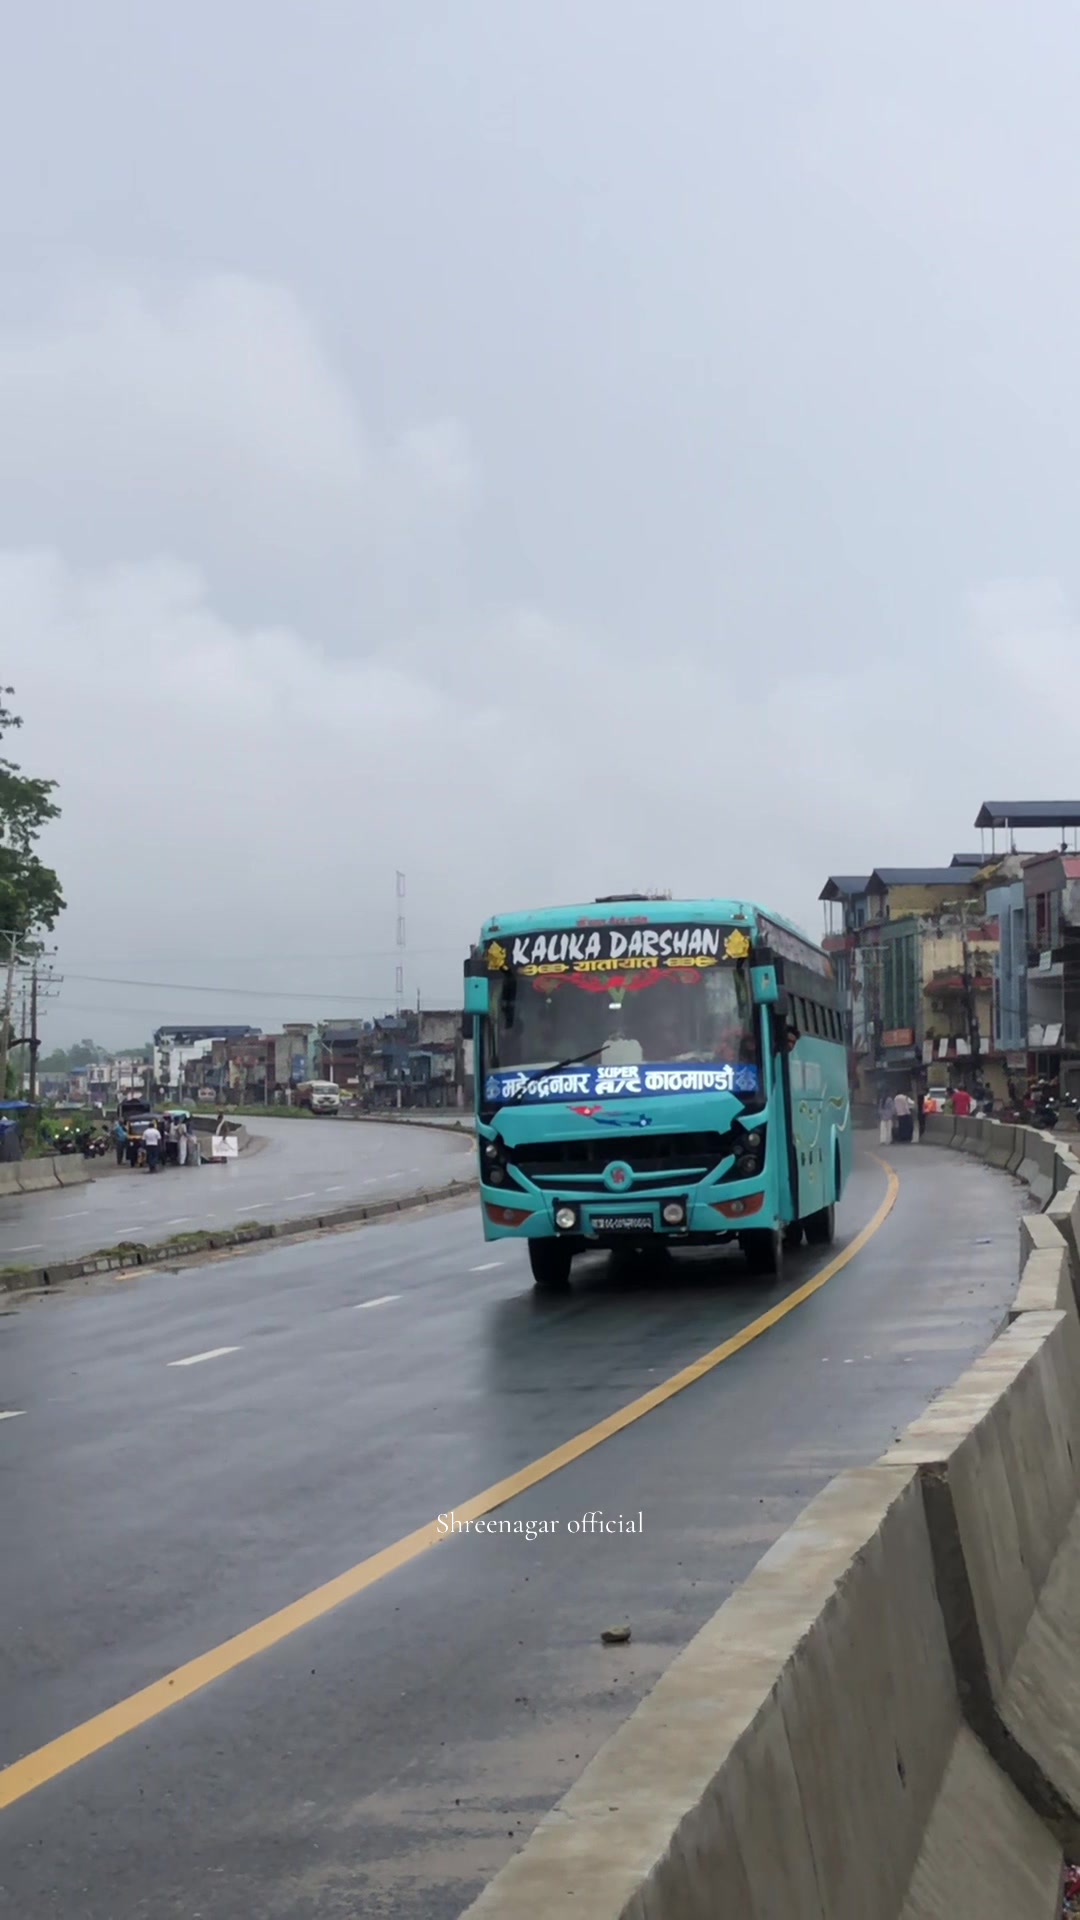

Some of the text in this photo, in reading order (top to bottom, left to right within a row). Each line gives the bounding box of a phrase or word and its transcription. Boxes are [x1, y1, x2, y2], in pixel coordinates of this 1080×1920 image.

[512, 928, 720, 966] KALIKA DARSHAN
[573, 957, 659, 972] यातायात
[597, 1066, 639, 1079] SUPER
[645, 1064, 734, 1092] काठमाण्डौ
